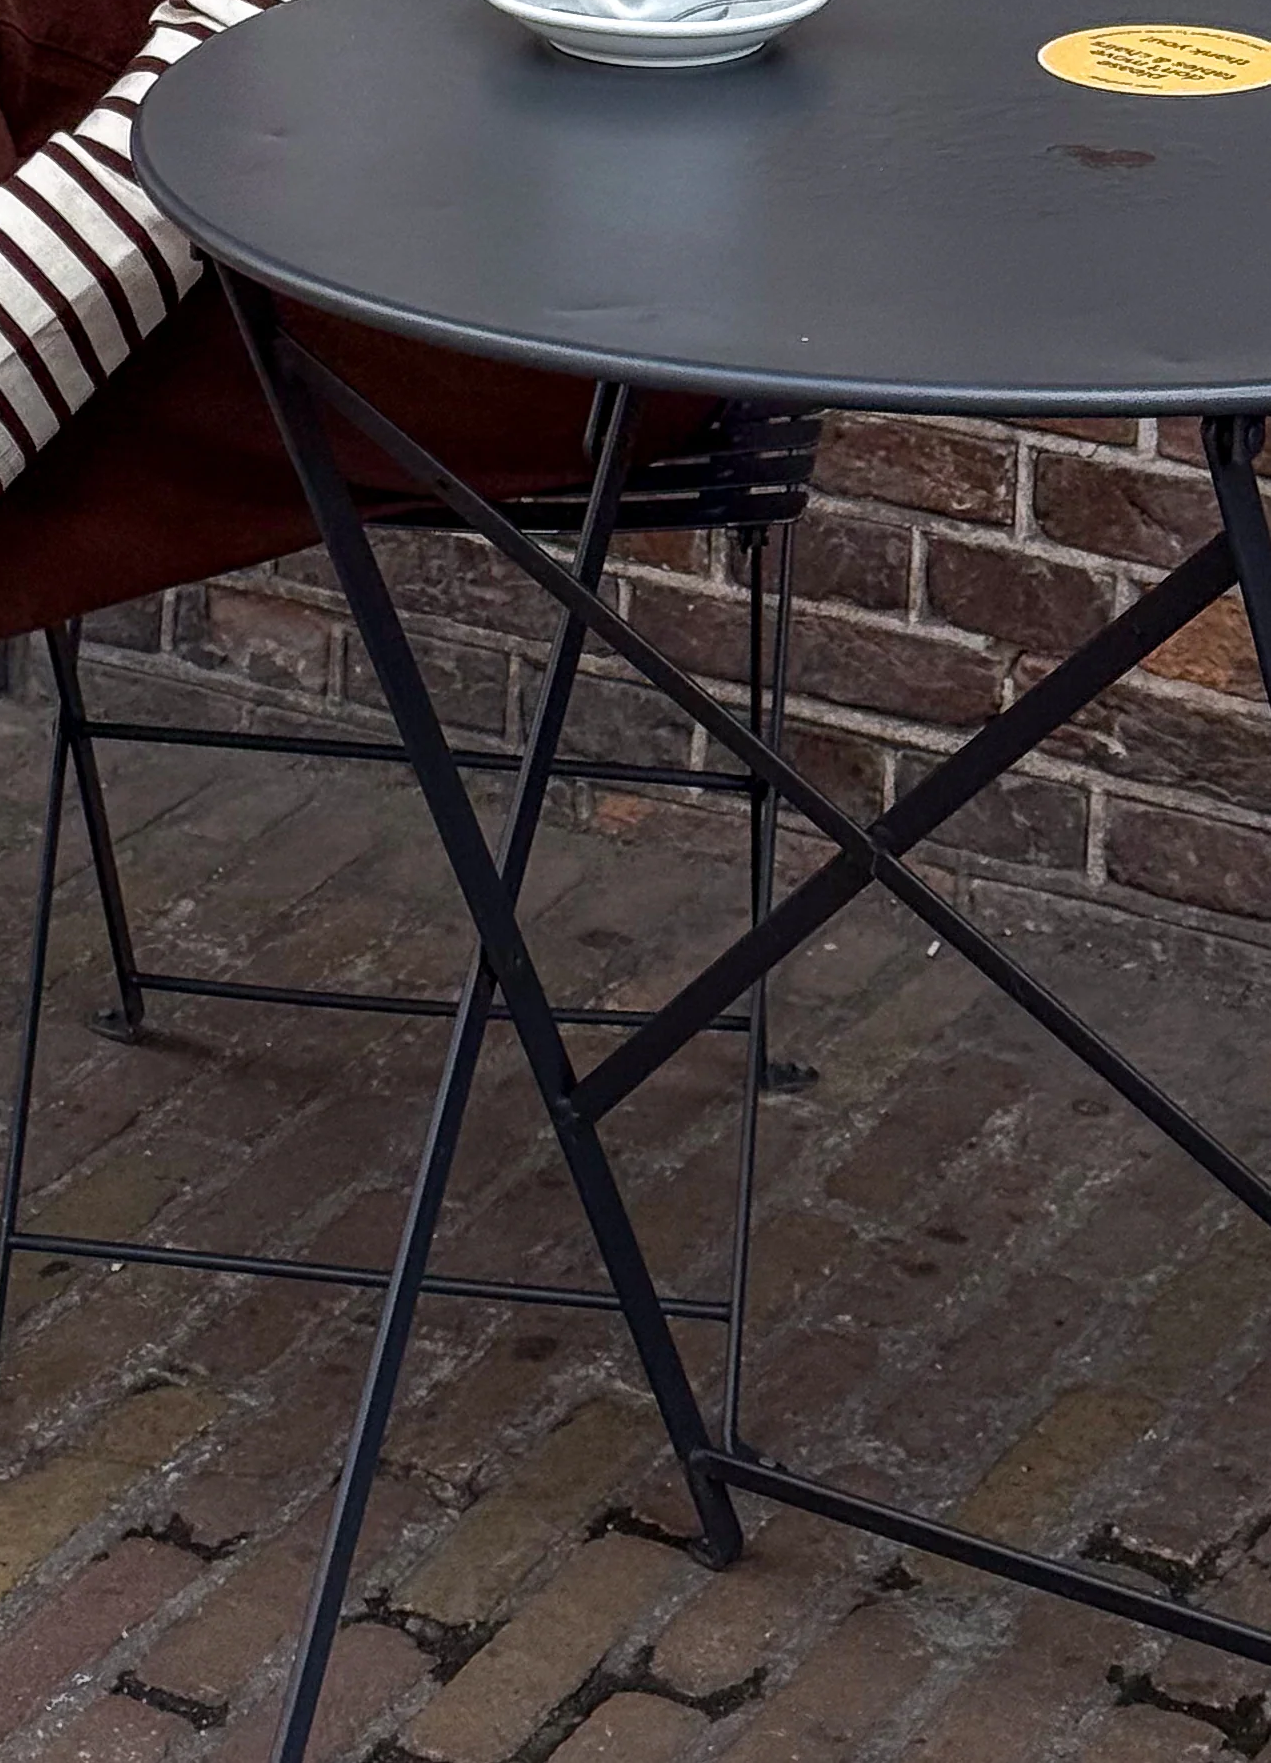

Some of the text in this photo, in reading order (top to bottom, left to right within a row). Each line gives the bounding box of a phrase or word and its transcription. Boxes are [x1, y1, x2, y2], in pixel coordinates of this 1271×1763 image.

[1090, 40, 1153, 60] chairs
[1139, 35, 1192, 52] you!
[1089, 49, 1149, 69] move
[1189, 46, 1251, 66] thank
[1096, 60, 1169, 80] please
[1171, 60, 1238, 80] tables
